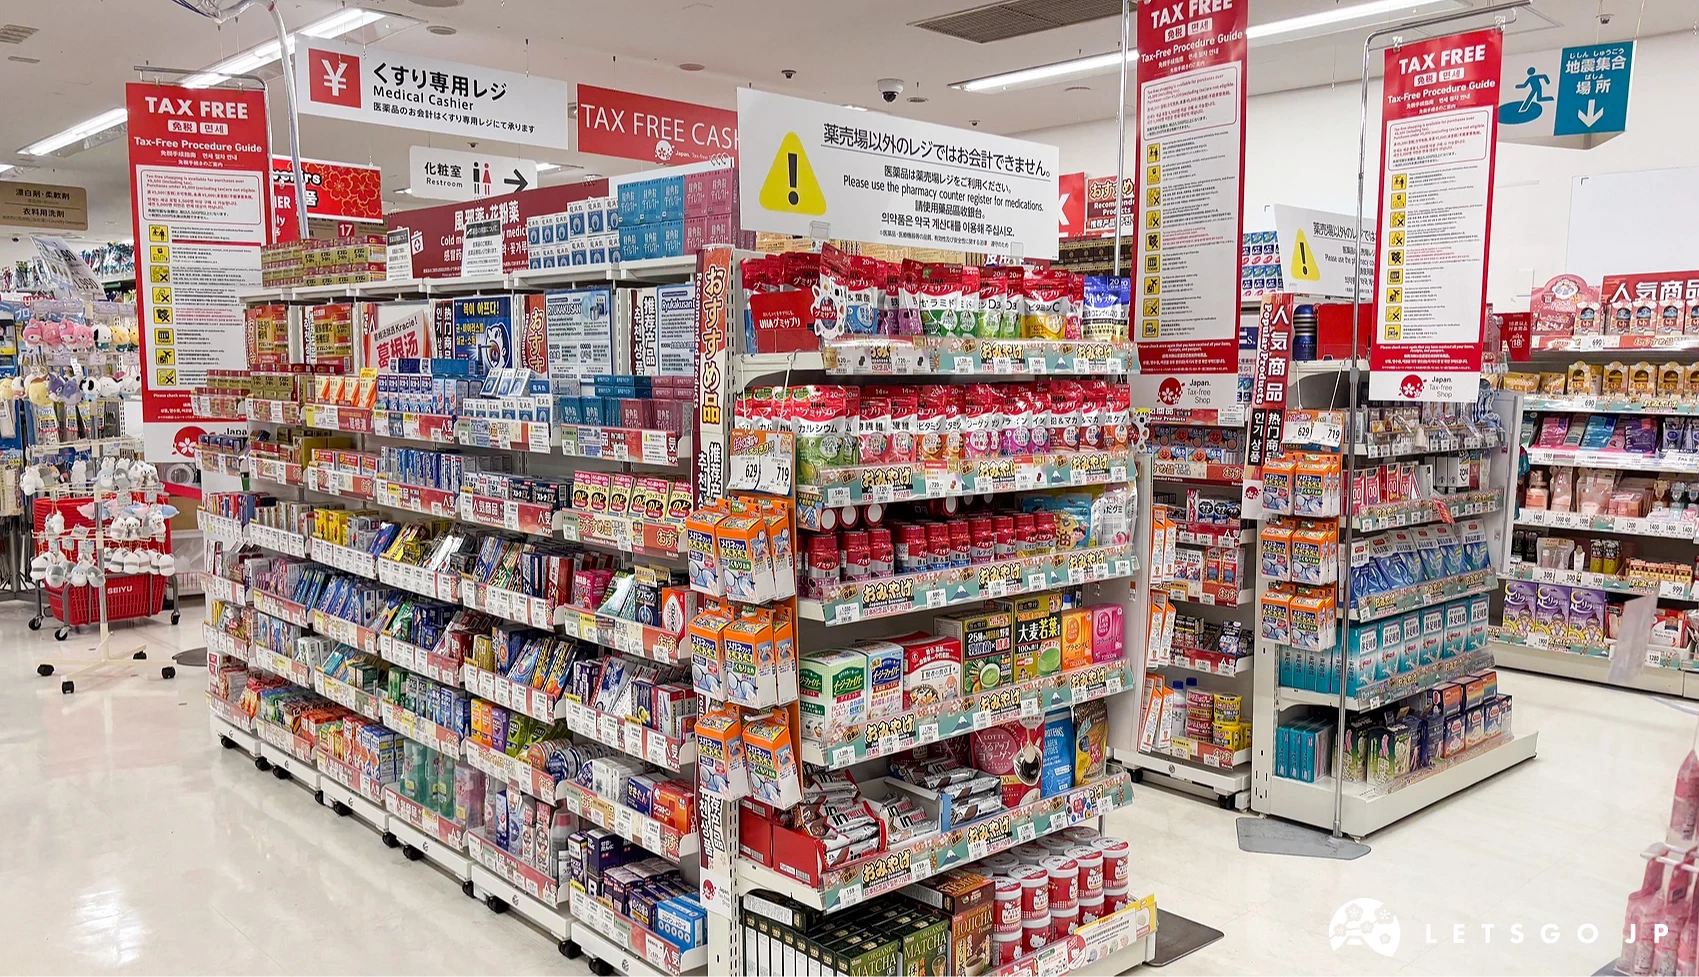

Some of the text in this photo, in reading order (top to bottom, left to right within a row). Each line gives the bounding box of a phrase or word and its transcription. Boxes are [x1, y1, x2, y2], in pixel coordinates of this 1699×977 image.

[1151, 2, 1184, 30] TAX
[1191, 19, 1208, 32] 면세
[1141, 28, 1243, 63] Tax-Free Procedure Guide
[1569, 47, 1625, 60] じしん しゅうごう
[1399, 44, 1487, 75] TAX FREE
[1565, 55, 1627, 74] 地震集合
[373, 62, 508, 101] くすり専用レジ
[1443, 71, 1461, 81] 면세
[1387, 78, 1496, 104] Tax-Free Procedure Guide
[1575, 79, 1611, 96] 場所
[373, 85, 475, 112] Medical Cashier
[145, 96, 249, 120] TAX FREE
[373, 102, 536, 135] 医薬品のお会計はくすり専用レジにて承ります
[580, 103, 685, 143] TAX FREE
[172, 122, 193, 132] 免税
[204, 124, 225, 134] 면세
[133, 136, 263, 153] Tax-Free Procedure Guide
[823, 122, 1051, 178] 薬売場以外のレジではお会計できません。
[424, 161, 463, 179] 化粧室
[426, 178, 464, 188] Restroom
[883, 165, 1012, 195] 医薬品は薬売場レジをご利用ください。
[843, 175, 1044, 212] Please use the pharmacy counter register for medications.
[23, 207, 65, 218] 衣料用洗剤
[914, 200, 986, 219] 請使用藥品區收銀台。
[339, 224, 353, 236] 17
[881, 211, 1015, 238] 의약품은 약국 계산대를 이용해 주십시오.
[441, 234, 455, 246] Cold
[921, 284, 954, 293] グミサプリ
[1610, 281, 1699, 303] 人気商品
[463, 300, 500, 316] 목이 아프다!
[547, 302, 581, 316] RYUKAKUSAN
[920, 299, 955, 308] セラミド
[1028, 302, 1061, 313] ビタミンC
[759, 315, 801, 330] UHAグミサプリ
[643, 296, 656, 367] 推荐产品
[633, 306, 645, 376] 추천상품
[702, 265, 726, 425] おすすめ品
[1592, 338, 1603, 347] 690
[376, 330, 419, 371] 葛根汤
[982, 342, 1025, 360] おみやげ
[1255, 303, 1272, 405] Popular Products
[1265, 305, 1289, 403] 人気商品
[1189, 378, 1211, 388] Japan.
[1431, 376, 1453, 384] Japan.
[1187, 388, 1211, 396] Tax-free
[1194, 396, 1211, 404] Shop
[1436, 391, 1453, 399] Shop
[1584, 399, 1595, 407] 690
[800, 407, 838, 417] グミサプリ
[798, 424, 838, 434] カルシウム
[917, 420, 942, 431] ビタミン
[1298, 426, 1310, 437] 629
[1328, 428, 1340, 439] 719
[1250, 411, 1265, 463] 인기상품
[1265, 411, 1281, 463] 热门商品
[1071, 453, 1109, 470] おみやげ
[745, 464, 758, 479] 629
[777, 466, 790, 482] 719
[862, 467, 912, 486] おみやげ
[575, 491, 588, 501] のど
[592, 491, 605, 502] のど
[611, 494, 625, 504] のど
[473, 500, 498, 516] 人気商品
[648, 501, 664, 514] のど
[672, 500, 691, 512] のど
[538, 510, 552, 525] 人気
[978, 562, 1022, 584] おみやげ
[107, 585, 133, 594] SEIYU
[862, 578, 914, 603] おみやげ
[1672, 585, 1683, 594] 999
[1017, 616, 1059, 644] 大麦若葉
[978, 688, 1021, 713] おみやげ
[865, 714, 916, 744] おみやげ
[983, 733, 1006, 741] LOTTE
[978, 749, 1015, 763] コラーゲン
[887, 803, 901, 818] in
[832, 812, 849, 827] in
[900, 814, 914, 829] in
[968, 815, 1011, 844] おみやげ
[863, 850, 912, 881] おみやげ
[919, 923, 946, 939] ORGANIC
[953, 909, 993, 938] HOJICHA
[867, 943, 895, 961] ORGANIC
[904, 932, 947, 961] MATCHA
